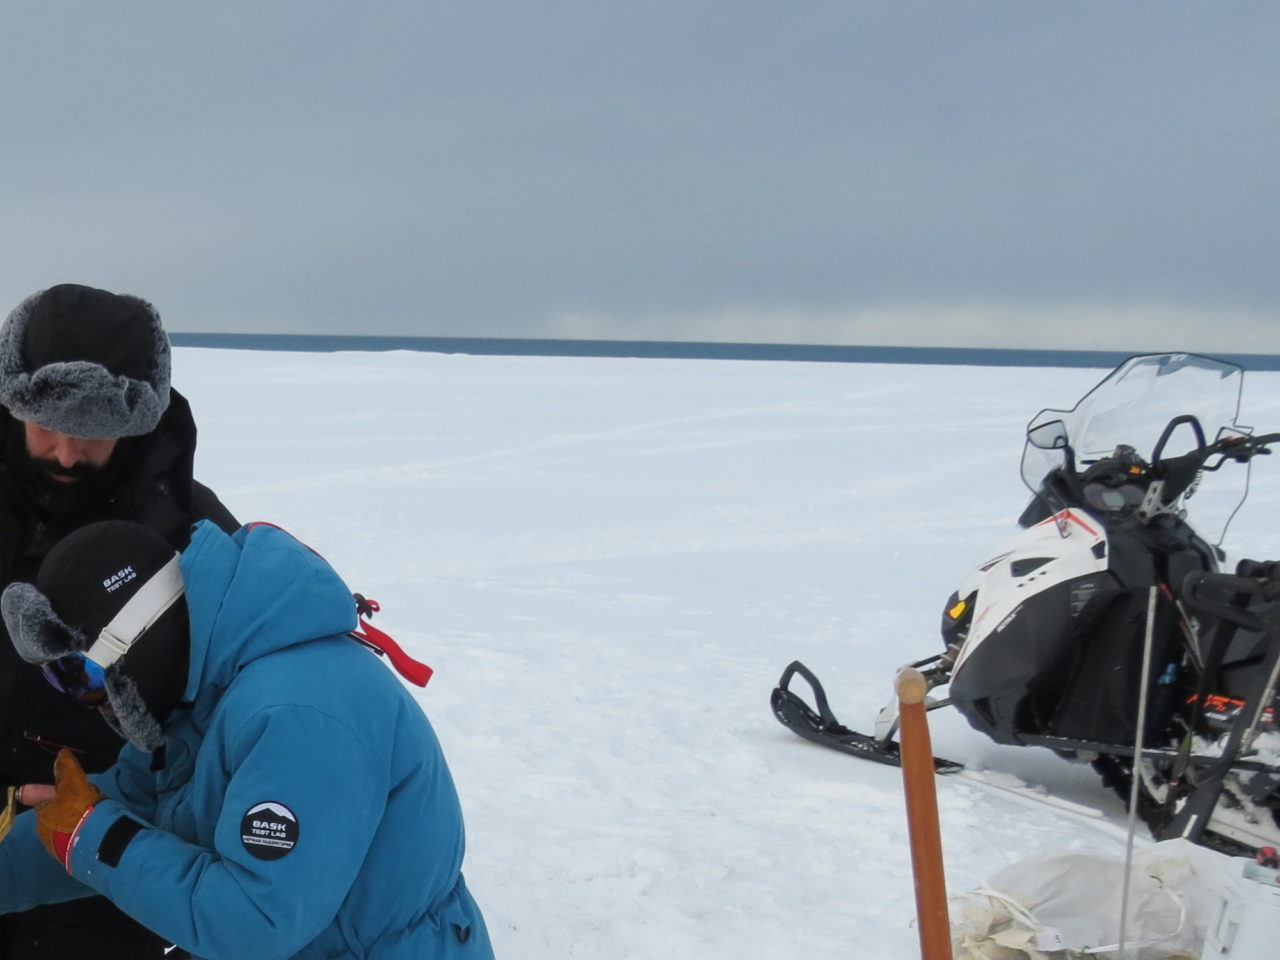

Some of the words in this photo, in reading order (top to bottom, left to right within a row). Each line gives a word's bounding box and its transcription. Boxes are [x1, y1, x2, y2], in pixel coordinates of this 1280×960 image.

[103, 565, 133, 588] BASK
[106, 580, 123, 593] TEST
[123, 572, 137, 583] LAB
[251, 828, 270, 836] TEST
[252, 820, 287, 831] BASK
